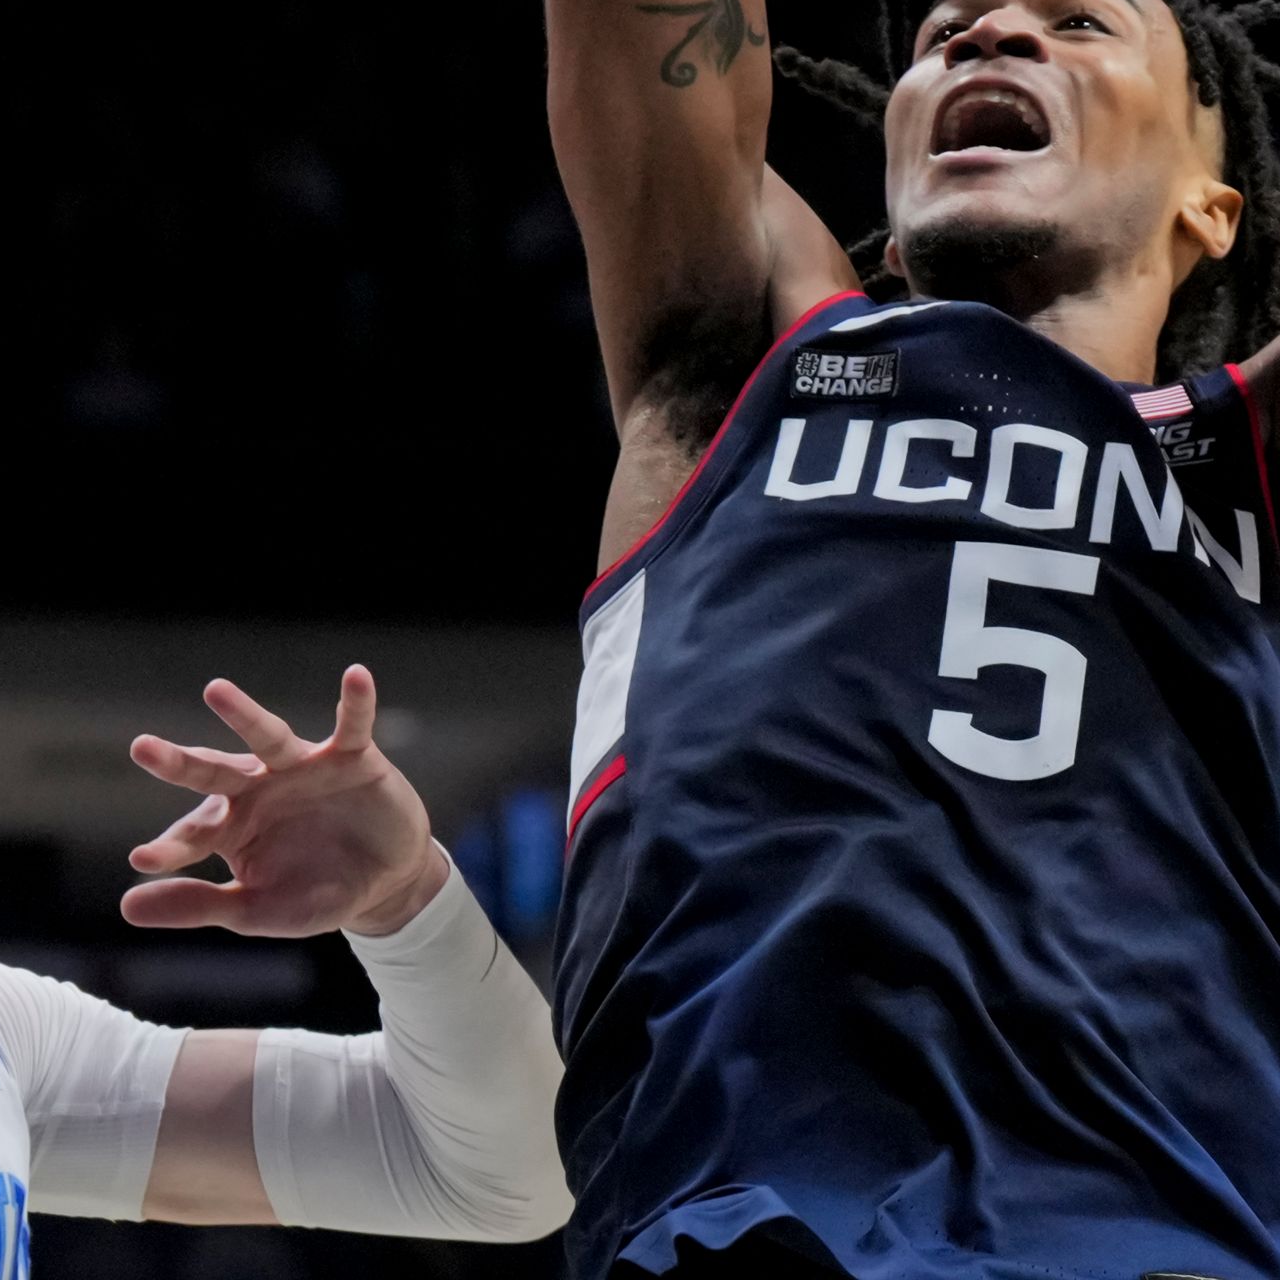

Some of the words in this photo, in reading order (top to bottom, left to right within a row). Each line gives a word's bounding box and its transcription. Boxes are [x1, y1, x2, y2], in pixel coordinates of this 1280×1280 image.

[795, 376, 893, 396] CHANGE
[1149, 421, 1193, 446] IG
[764, 418, 1261, 604] UCONN
[927, 541, 1101, 781] 5
